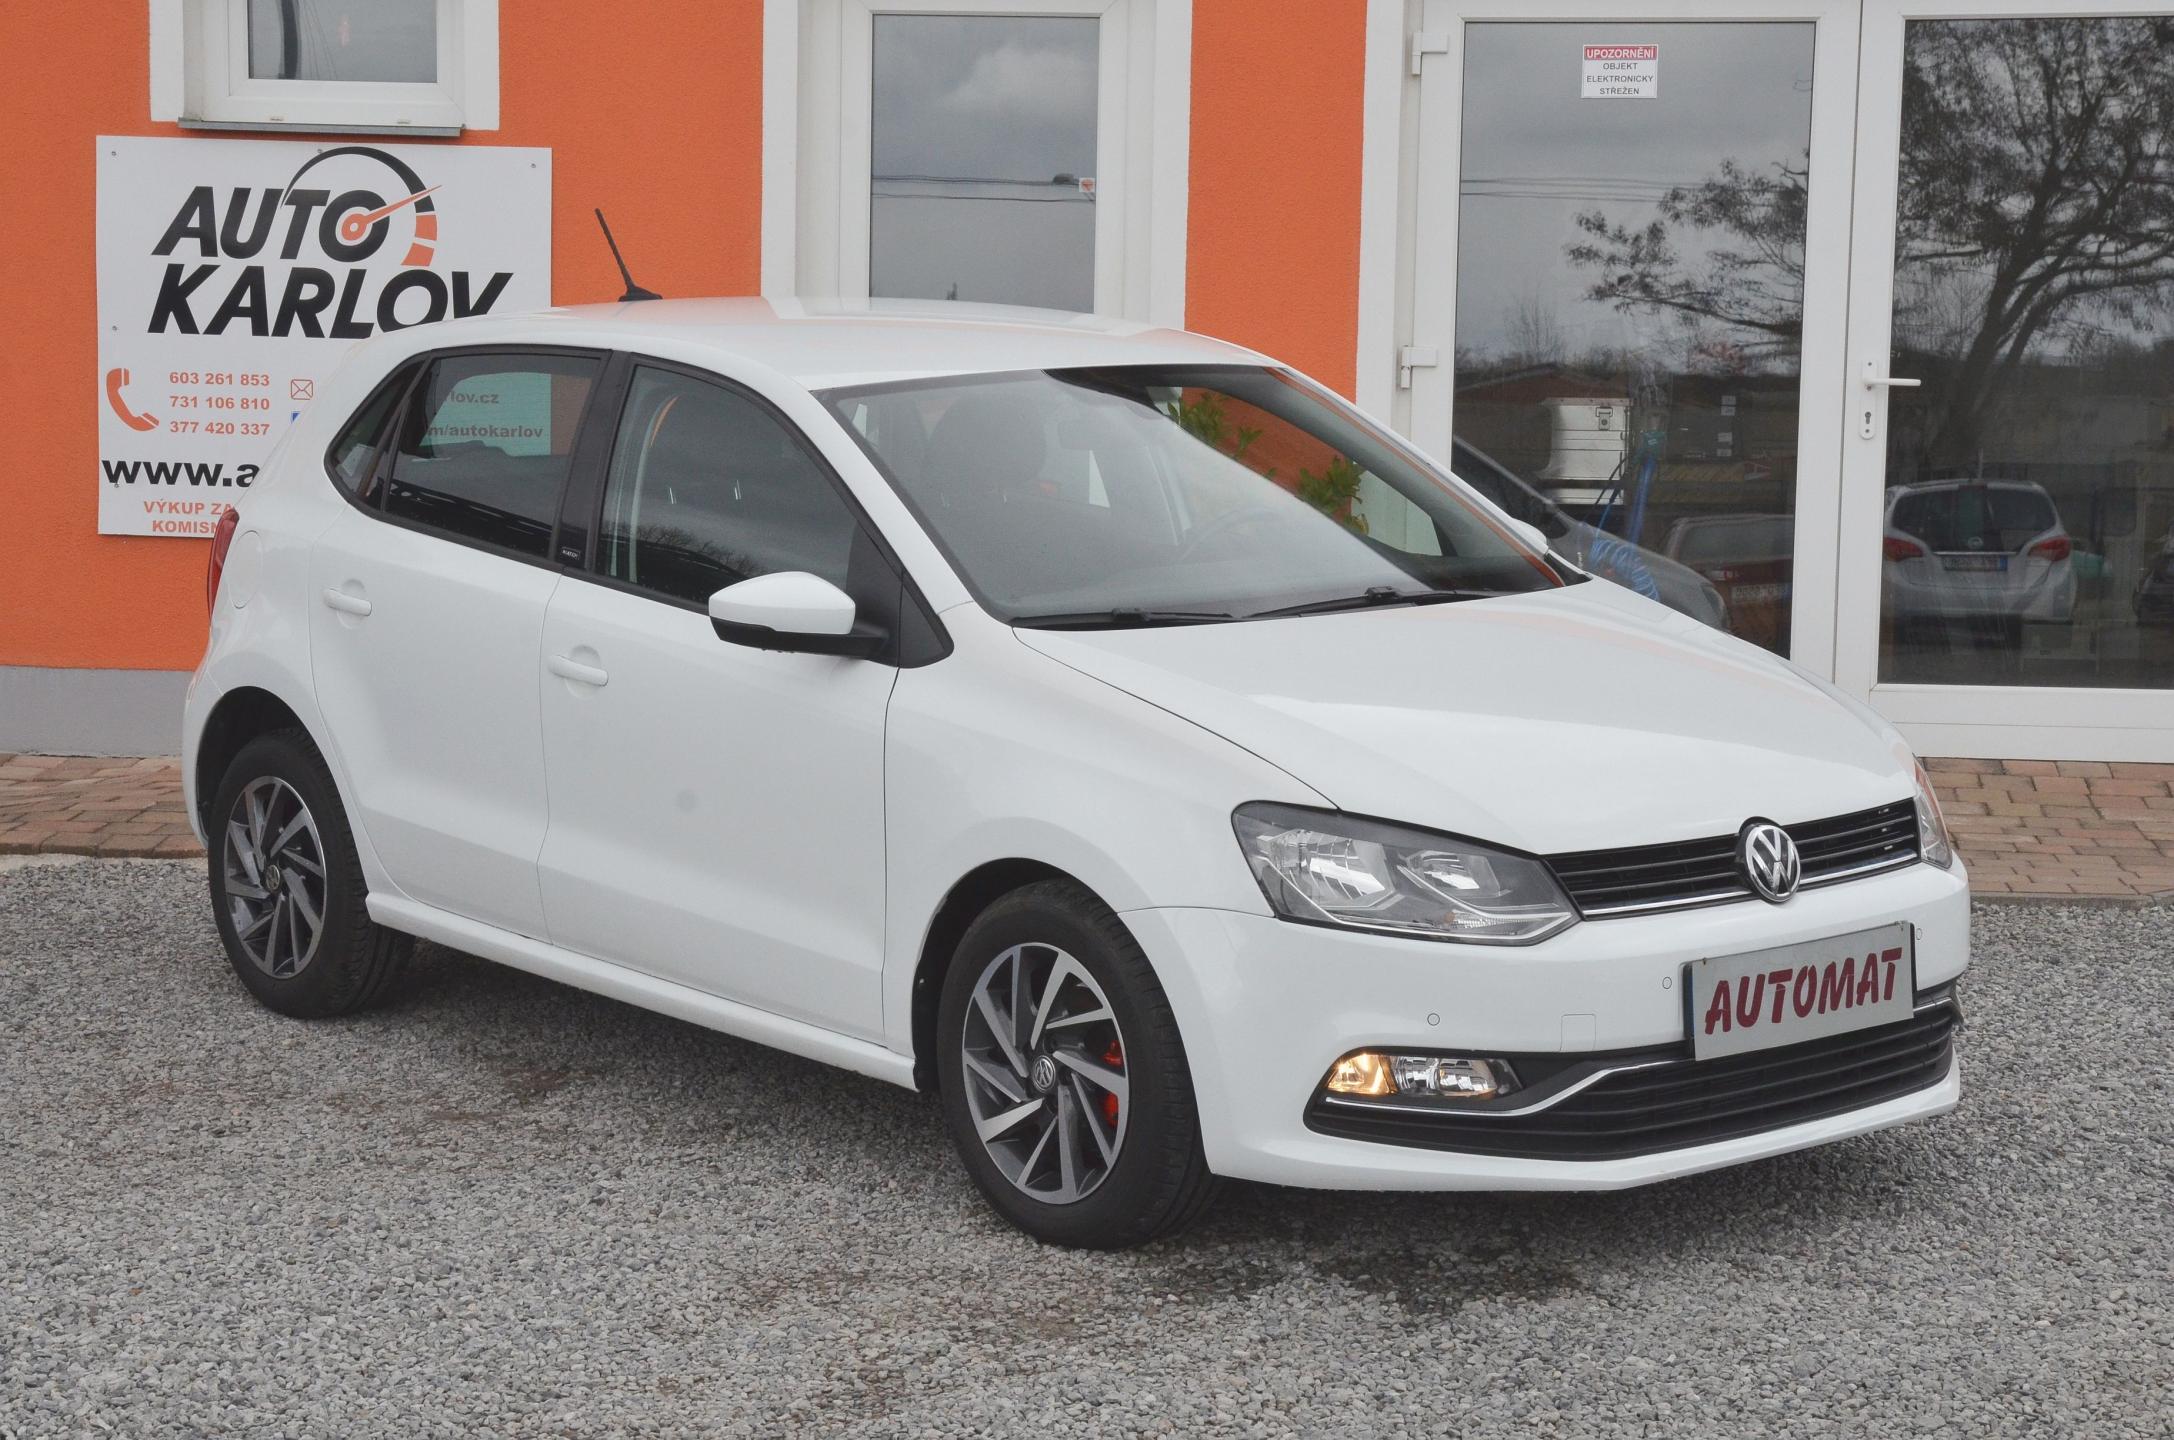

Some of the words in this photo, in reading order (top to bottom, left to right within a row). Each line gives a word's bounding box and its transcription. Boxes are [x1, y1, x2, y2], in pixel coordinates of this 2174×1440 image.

[1586, 47, 1654, 59] UPOZORNĚNÍ
[1603, 62, 1638, 70] OBJEKT
[1586, 75, 1654, 83] ELEKTRONICKY
[1599, 86, 1640, 95] STŘEŽEN
[151, 185, 391, 263] AUTO
[147, 263, 514, 340] KARLOV
[169, 371, 199, 384] 603
[204, 372, 235, 385] 261
[240, 373, 270, 386] 853
[169, 395, 199, 408] 731
[204, 396, 235, 409] 106
[240, 397, 270, 410] 810
[169, 420, 199, 433] 377
[204, 421, 235, 434] 420
[240, 422, 270, 435] 337
[101, 460, 260, 488] www.a
[143, 499, 205, 515] VÝKUP
[1704, 947, 1903, 1035] AUTOMAT
